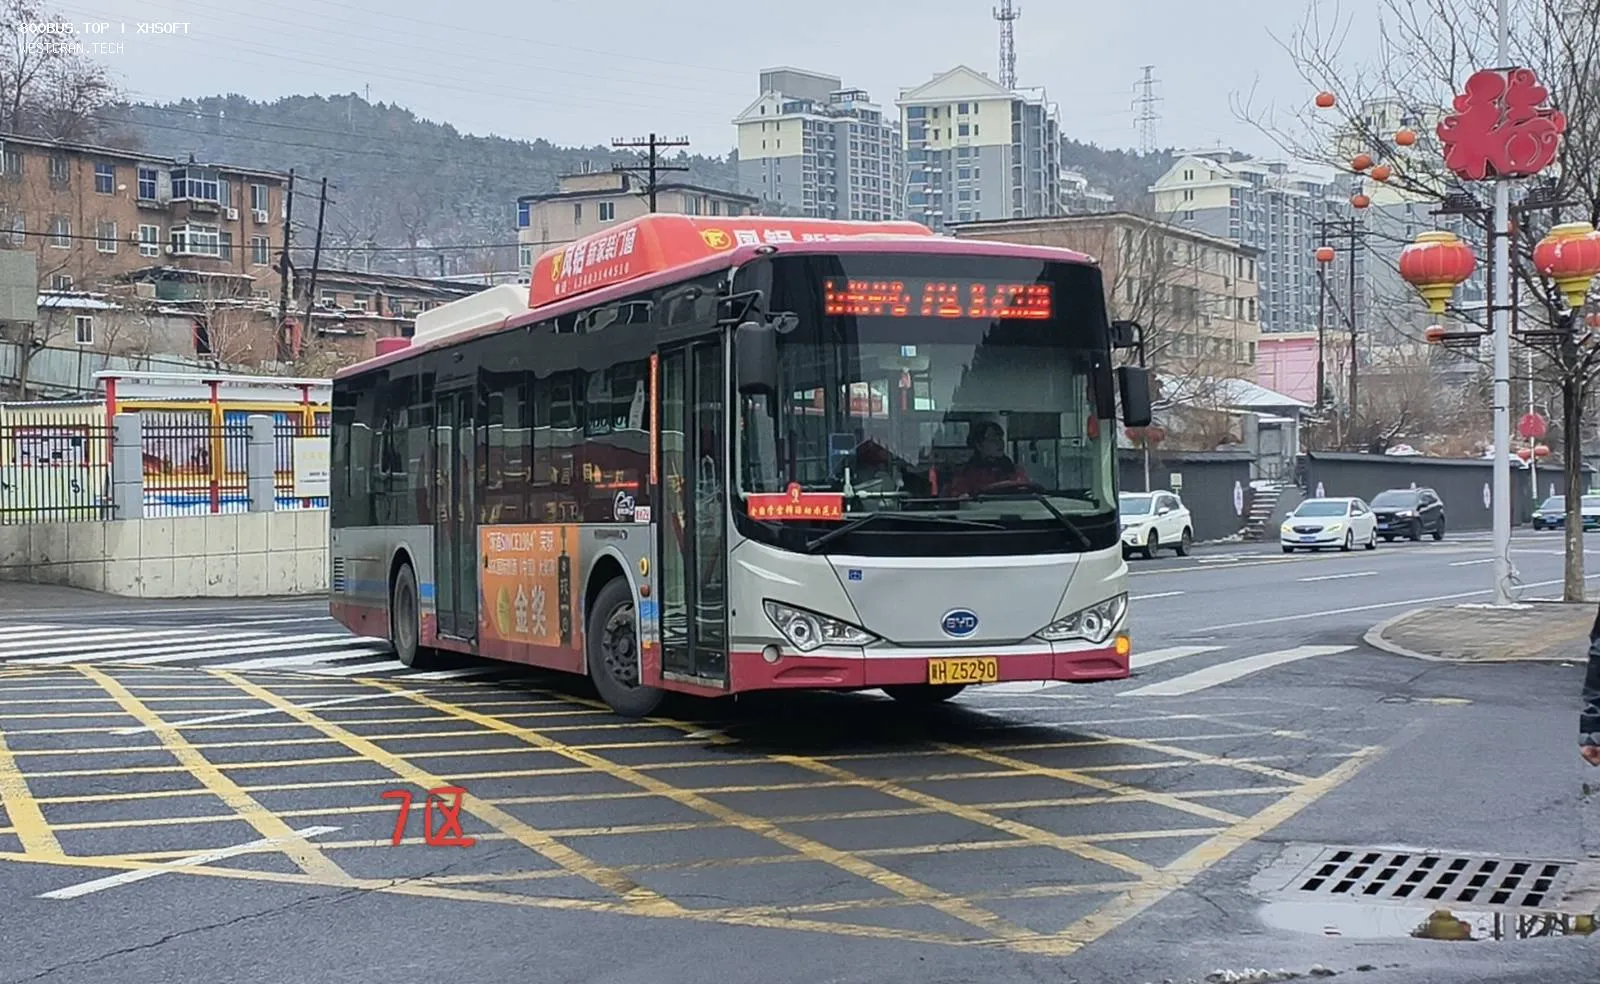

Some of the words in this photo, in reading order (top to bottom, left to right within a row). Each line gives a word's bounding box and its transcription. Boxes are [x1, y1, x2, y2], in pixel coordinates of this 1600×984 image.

[514, 583, 547, 637] 金奖
[946, 616, 975, 629] BYD
[951, 660, 996, 680] Z5290
